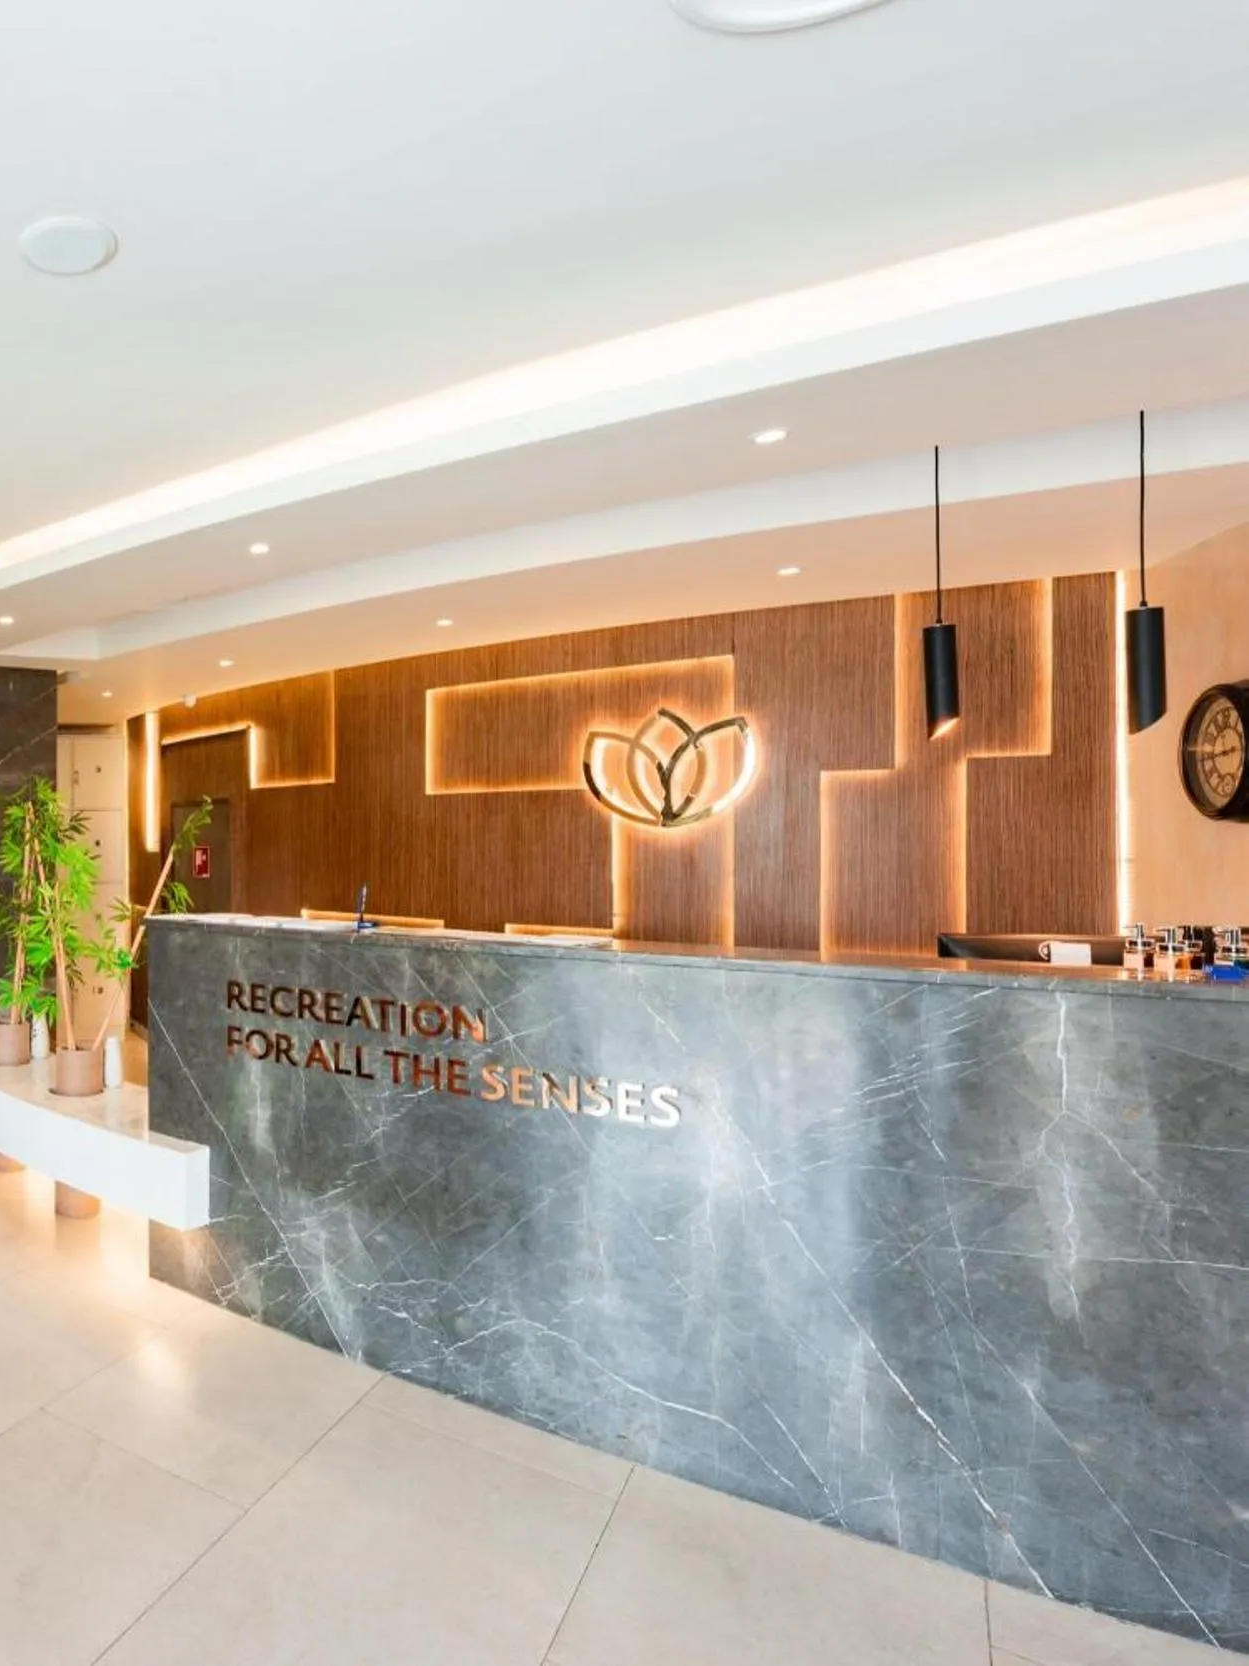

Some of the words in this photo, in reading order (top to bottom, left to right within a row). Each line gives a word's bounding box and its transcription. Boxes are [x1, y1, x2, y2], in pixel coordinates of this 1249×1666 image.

[227, 980, 490, 1044] RECREATION
[227, 1027, 296, 1067] FOR
[305, 1040, 376, 1080] ALL
[384, 1049, 472, 1097] THE
[481, 1065, 683, 1129] SENSES
